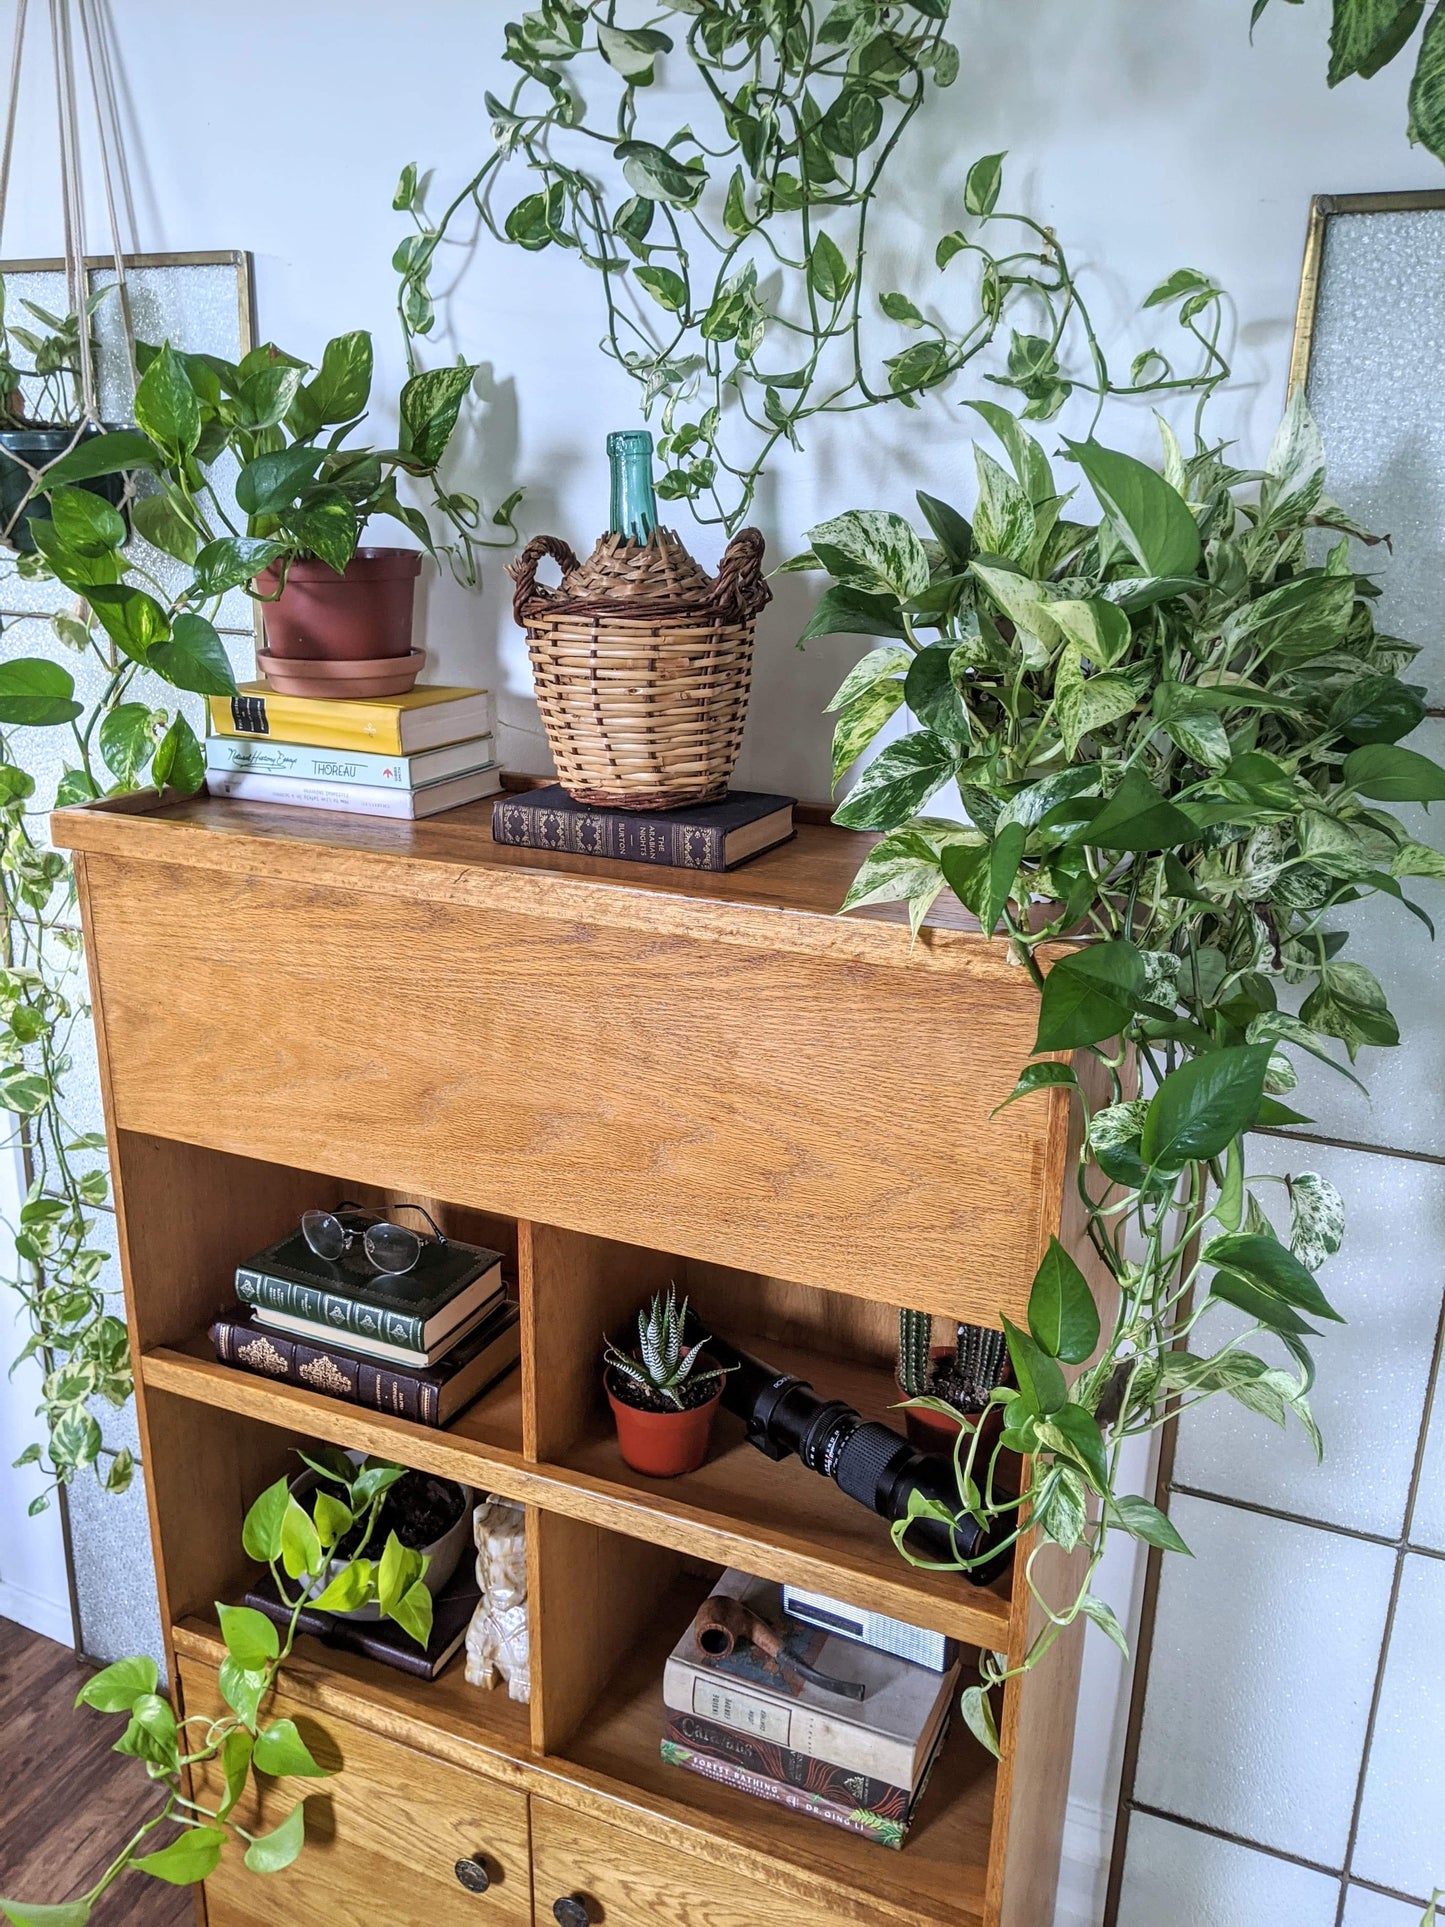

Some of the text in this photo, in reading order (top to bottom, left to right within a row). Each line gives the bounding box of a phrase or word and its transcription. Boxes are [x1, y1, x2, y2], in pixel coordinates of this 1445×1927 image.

[250, 749, 276, 765] History
[311, 759, 368, 778] THOREAU
[618, 822, 626, 855] BURTON
[639, 826, 647, 857] NIGHTS
[711, 1694, 720, 1716] INSIDE
[723, 1697, 732, 1720] EUROPE
[693, 1757, 779, 1794] FOREST BATHING
[805, 1803, 865, 1832] DR. QING LI
